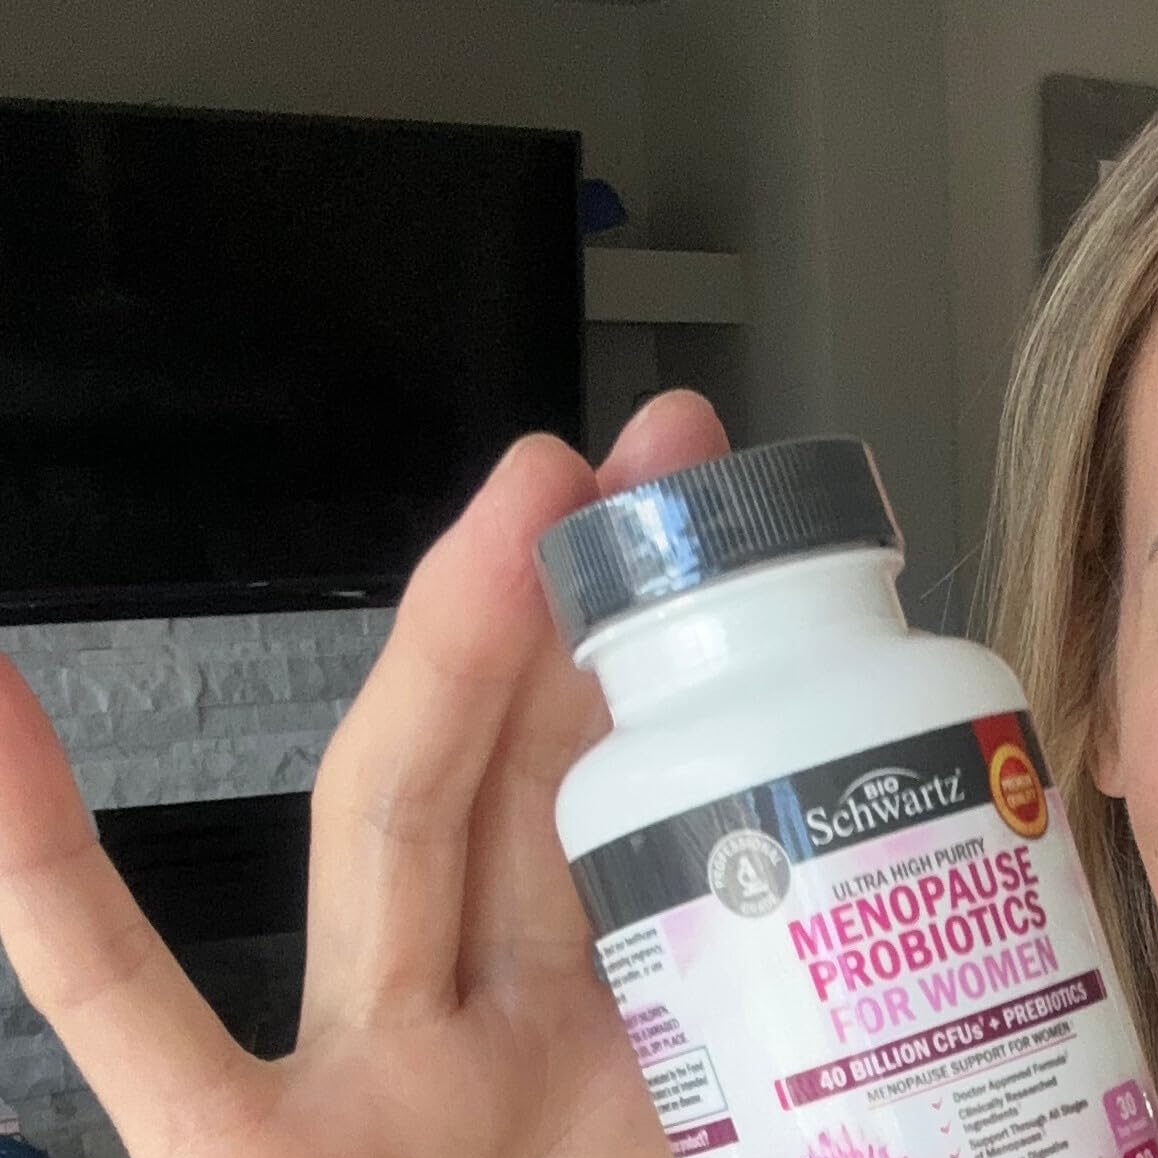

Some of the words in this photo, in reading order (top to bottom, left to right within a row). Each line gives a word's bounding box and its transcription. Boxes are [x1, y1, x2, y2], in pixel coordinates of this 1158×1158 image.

[806, 770, 966, 847] Schwartz
[863, 775, 900, 801] BIO
[832, 871, 888, 901] ULTRA
[890, 853, 934, 883] HIGH
[936, 838, 986, 867] PURITY
[788, 846, 1039, 961] MENOPAUSE
[808, 890, 1047, 1001] PROBIOTICS
[830, 986, 916, 1044] FOR
[917, 935, 1060, 1014] WOMEN
[819, 1067, 848, 1091] 40
[850, 1037, 932, 1082] BILLION
[989, 1015, 1001, 1031] +
[1002, 982, 1088, 1029] PREBIOTICS
[866, 1067, 949, 1103] MENOPAUSE
[949, 1044, 1007, 1076] SUPPORT
[1008, 1035, 1031, 1058] FOR
[953, 1084, 987, 1104] Doctor
[988, 1066, 1032, 1090] Approved
[958, 1097, 1005, 1121] Clinically
[1004, 1076, 1058, 1103] Researched
[1115, 1090, 1138, 1121] 30
[968, 1128, 1010, 1151] Support
[1010, 1113, 1048, 1136] Through
[1048, 1107, 1061, 1121] All
